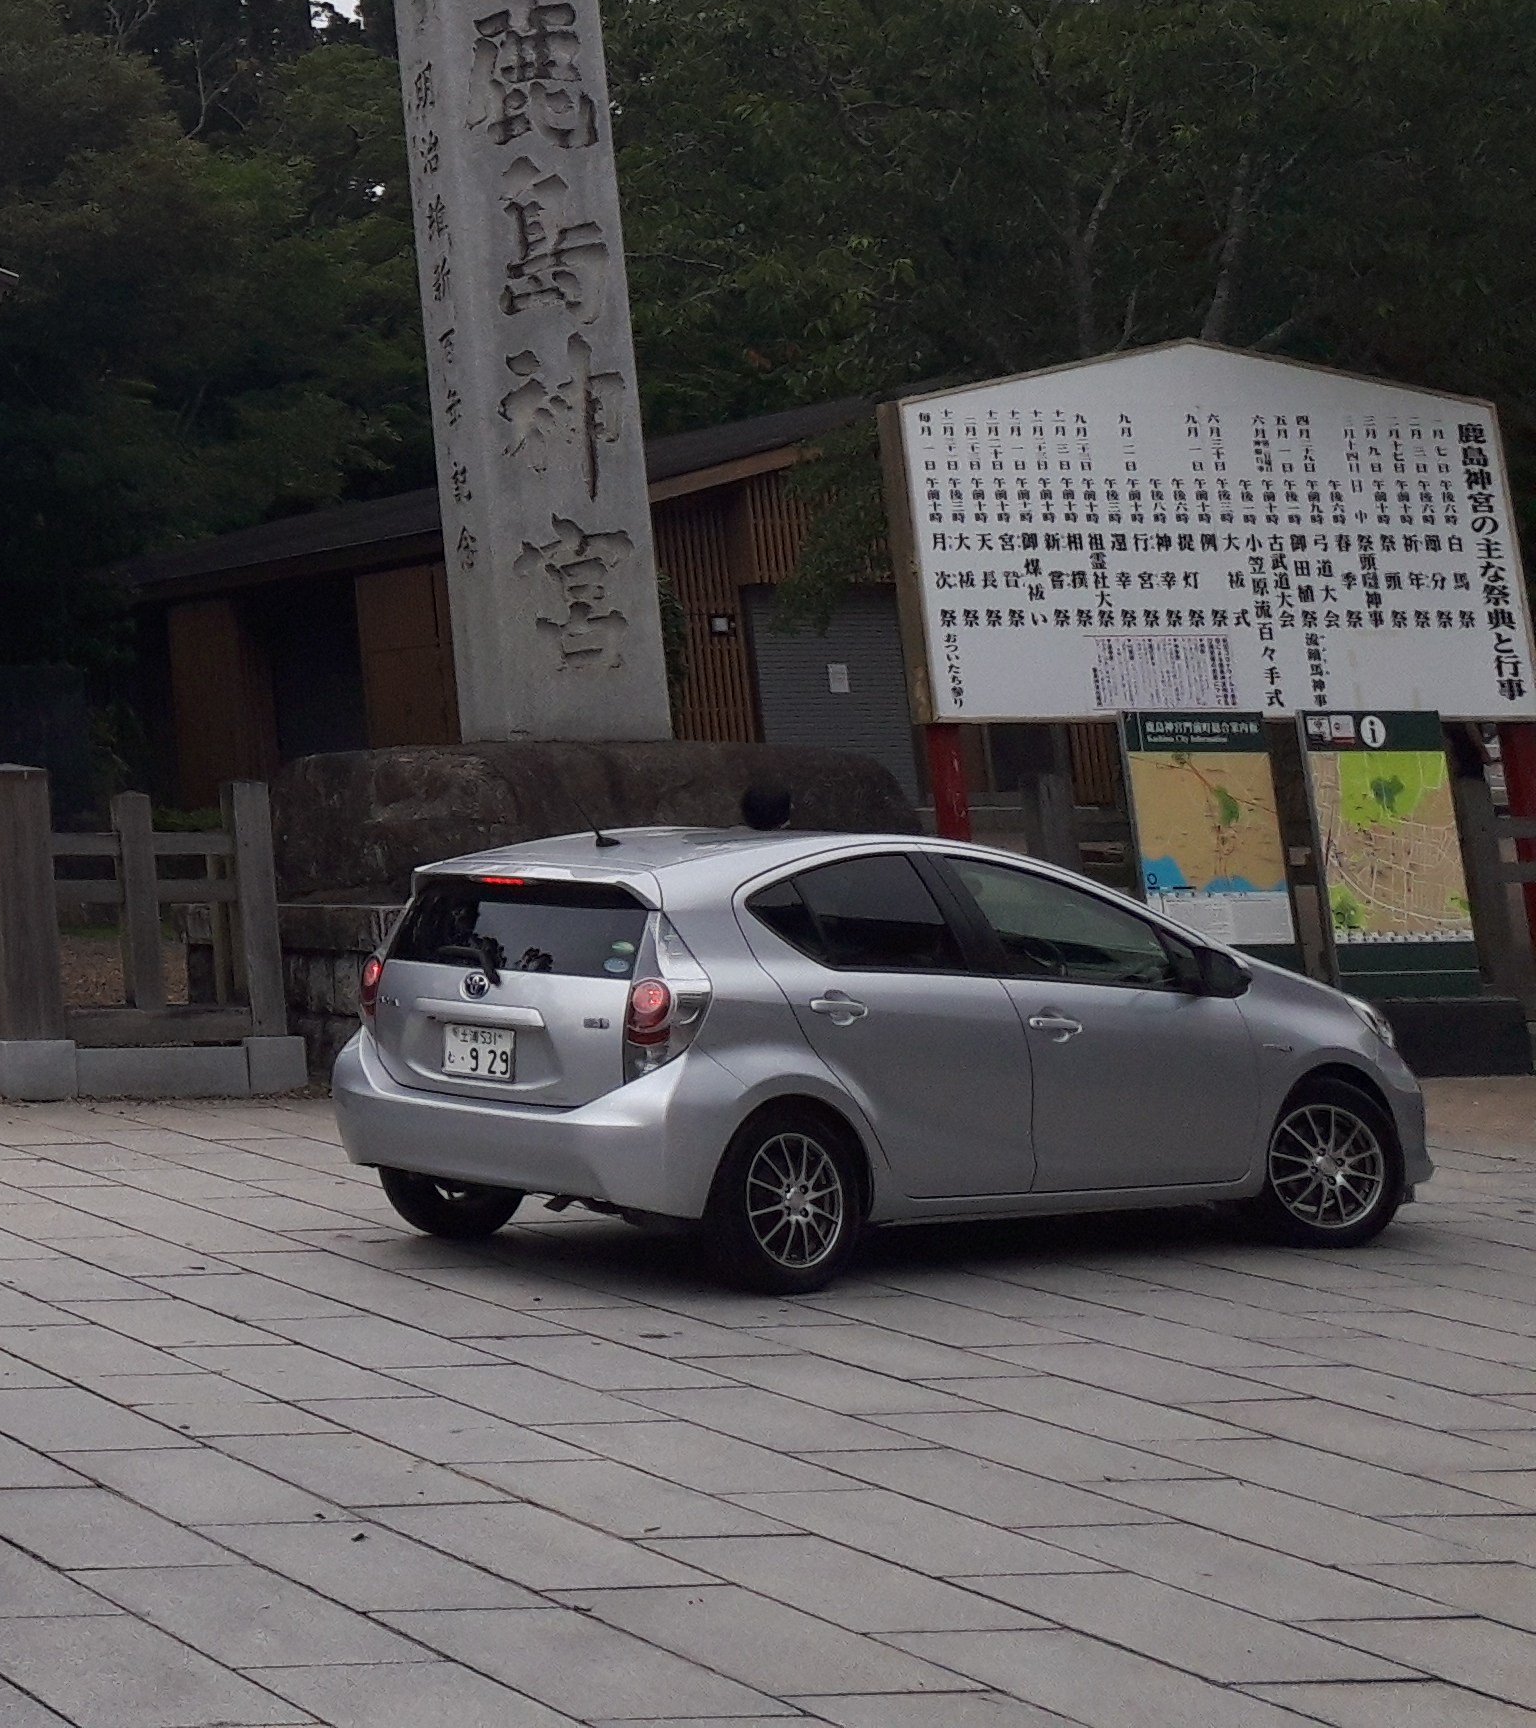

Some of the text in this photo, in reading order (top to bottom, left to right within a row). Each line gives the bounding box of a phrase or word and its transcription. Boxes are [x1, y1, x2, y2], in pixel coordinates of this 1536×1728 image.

[976, 533, 1002, 628] 天長祭
[1088, 533, 1114, 628] 祖霊社大祭
[1177, 533, 1205, 628] 提灯祭
[1268, 534, 1294, 628] 古武道大会
[1314, 535, 1340, 629] 弓道大会
[1448, 536, 1476, 629] 白馬祭
[1457, 423, 1526, 701] 鹿島神宮の主な祭典と行事
[932, 533, 956, 628] 月次祭
[944, 633, 964, 709] おついたち参り
[1246, 534, 1284, 708] 小笠原流百々手式
